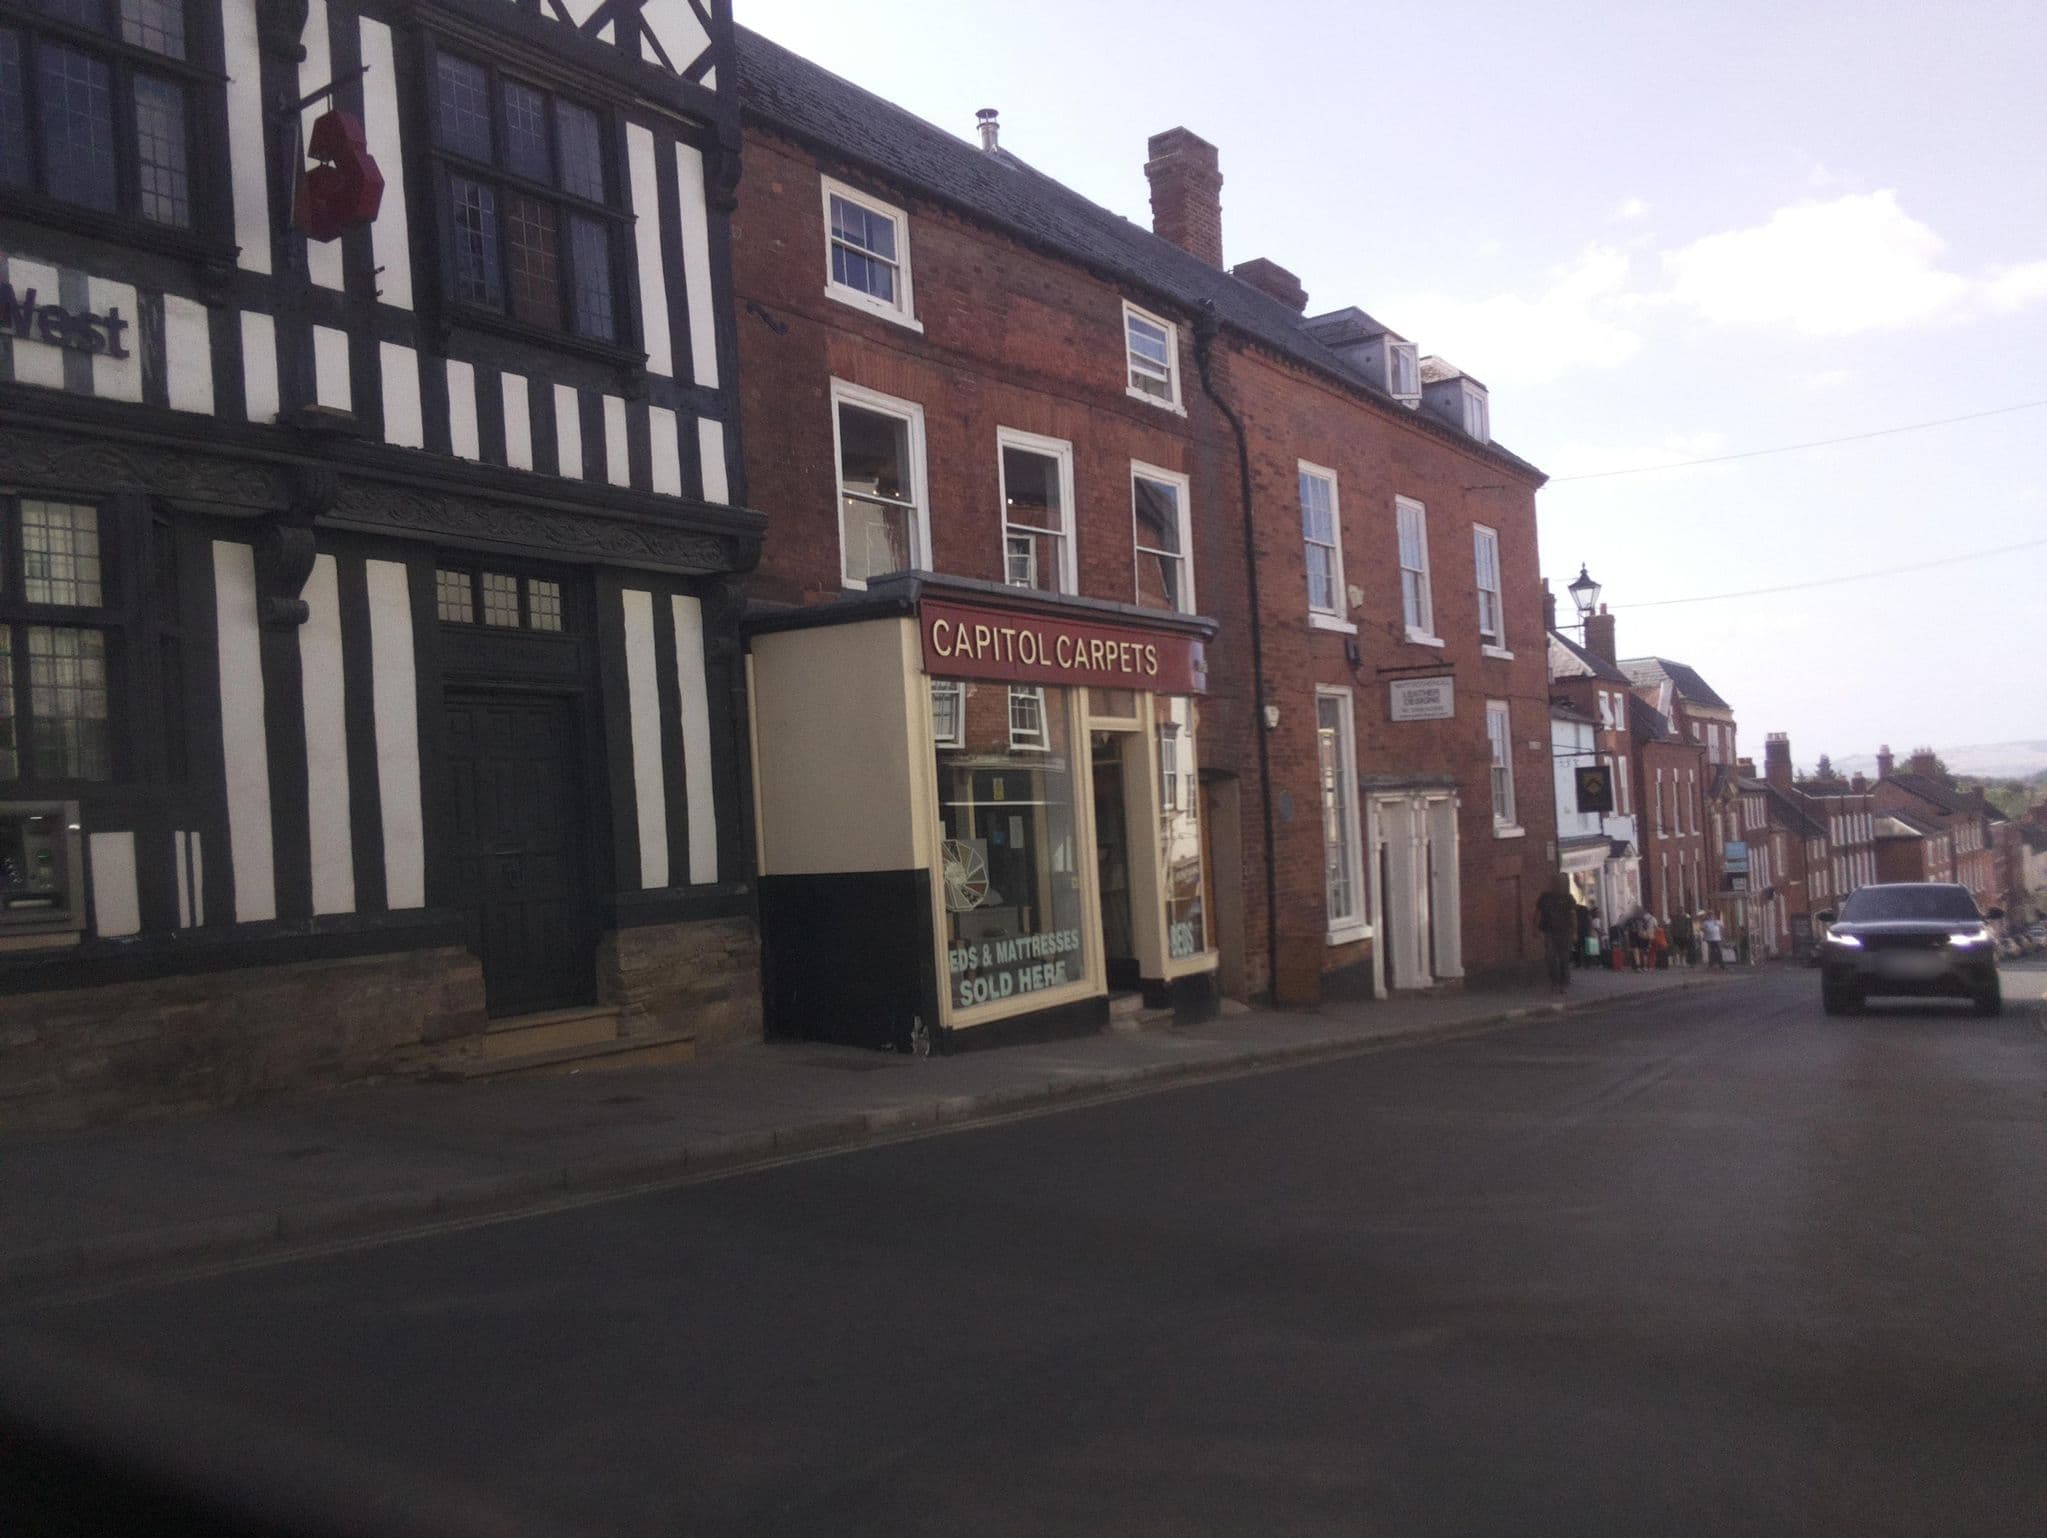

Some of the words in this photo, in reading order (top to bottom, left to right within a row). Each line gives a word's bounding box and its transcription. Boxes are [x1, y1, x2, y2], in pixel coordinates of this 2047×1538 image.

[932, 618, 1051, 667] CAPITOL
[1056, 635, 1158, 676] CARPETS
[982, 943, 993, 968] &
[996, 929, 1079, 964] MATTRESSES
[959, 972, 1013, 1007] SOLD
[1018, 960, 1068, 993] HERE
